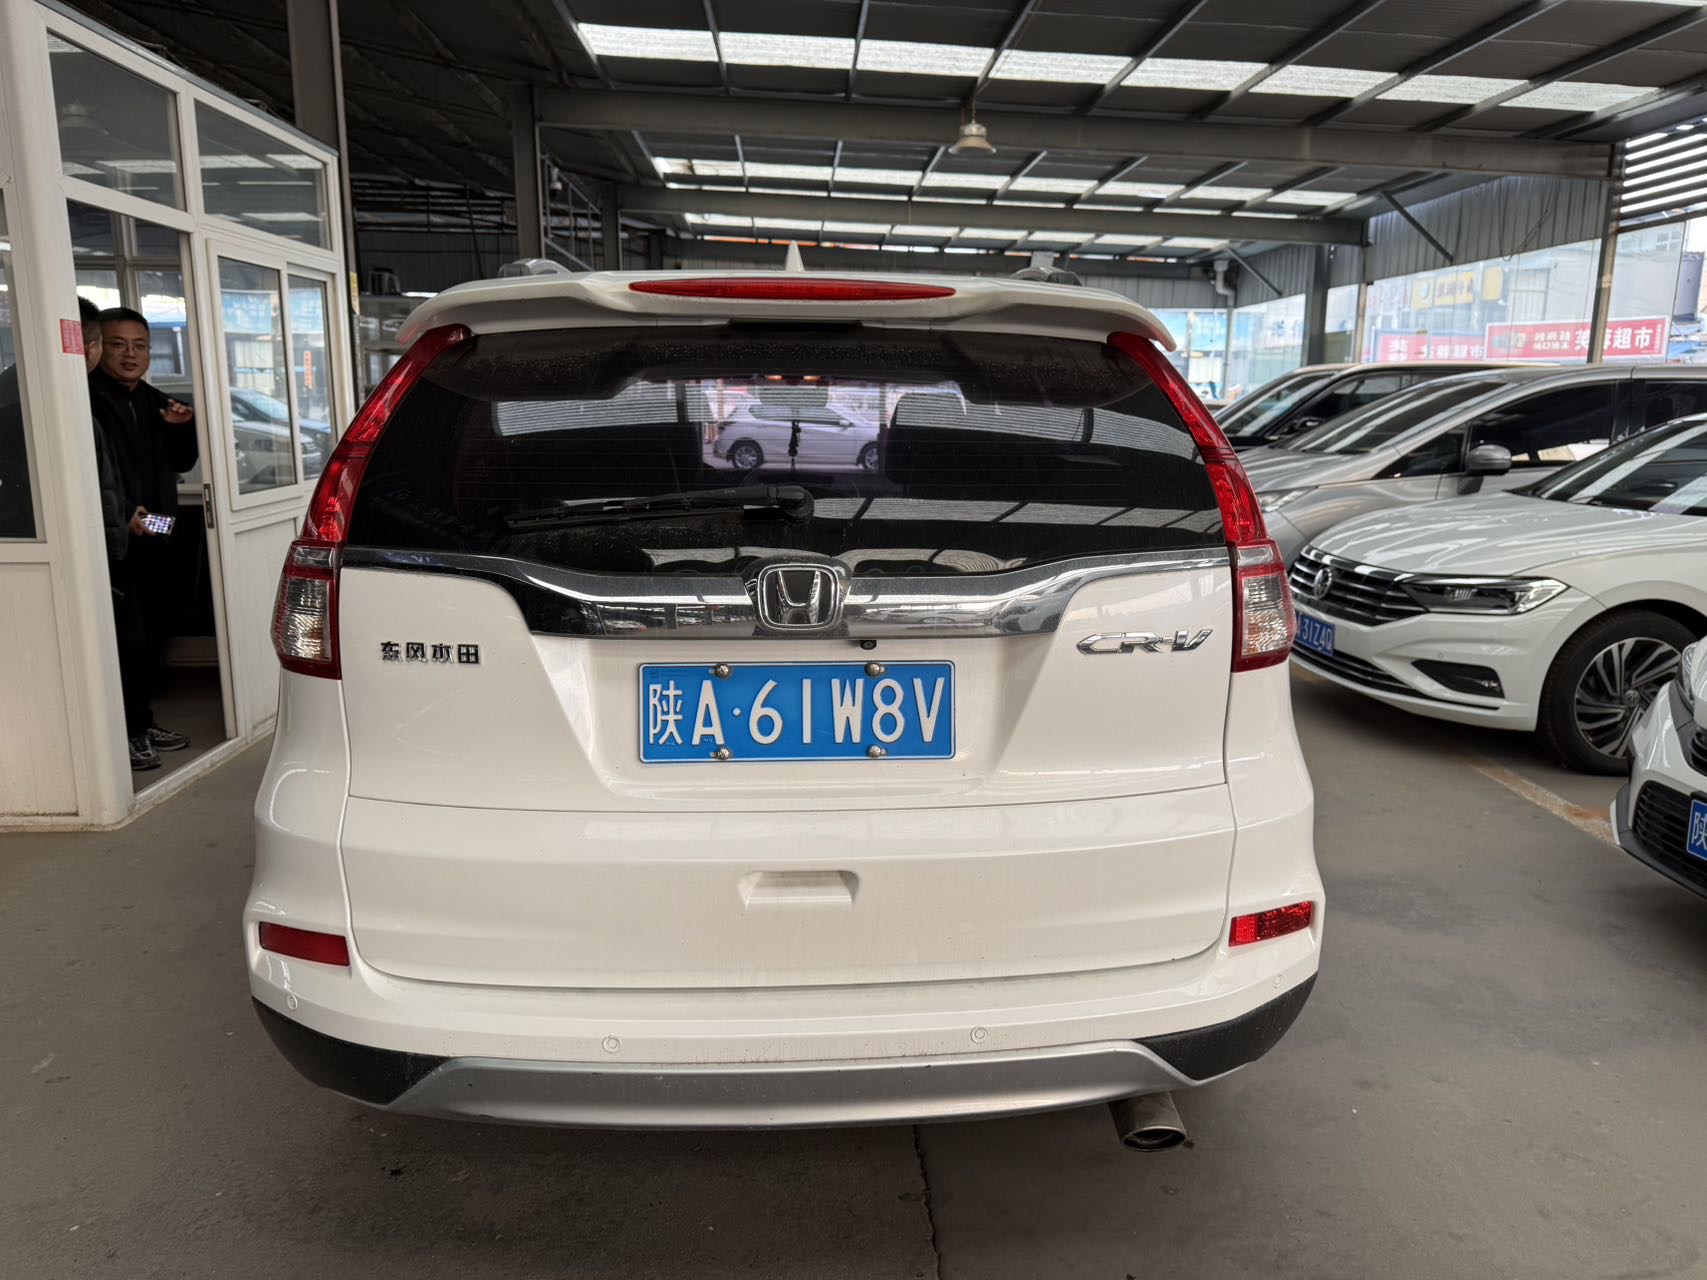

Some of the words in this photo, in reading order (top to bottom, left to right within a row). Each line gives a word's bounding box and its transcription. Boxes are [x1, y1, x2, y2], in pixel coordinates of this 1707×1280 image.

[1076, 629, 1214, 655] CR-V
[1297, 612, 1333, 651] 31Z40
[381, 641, 480, 664] 东风本田
